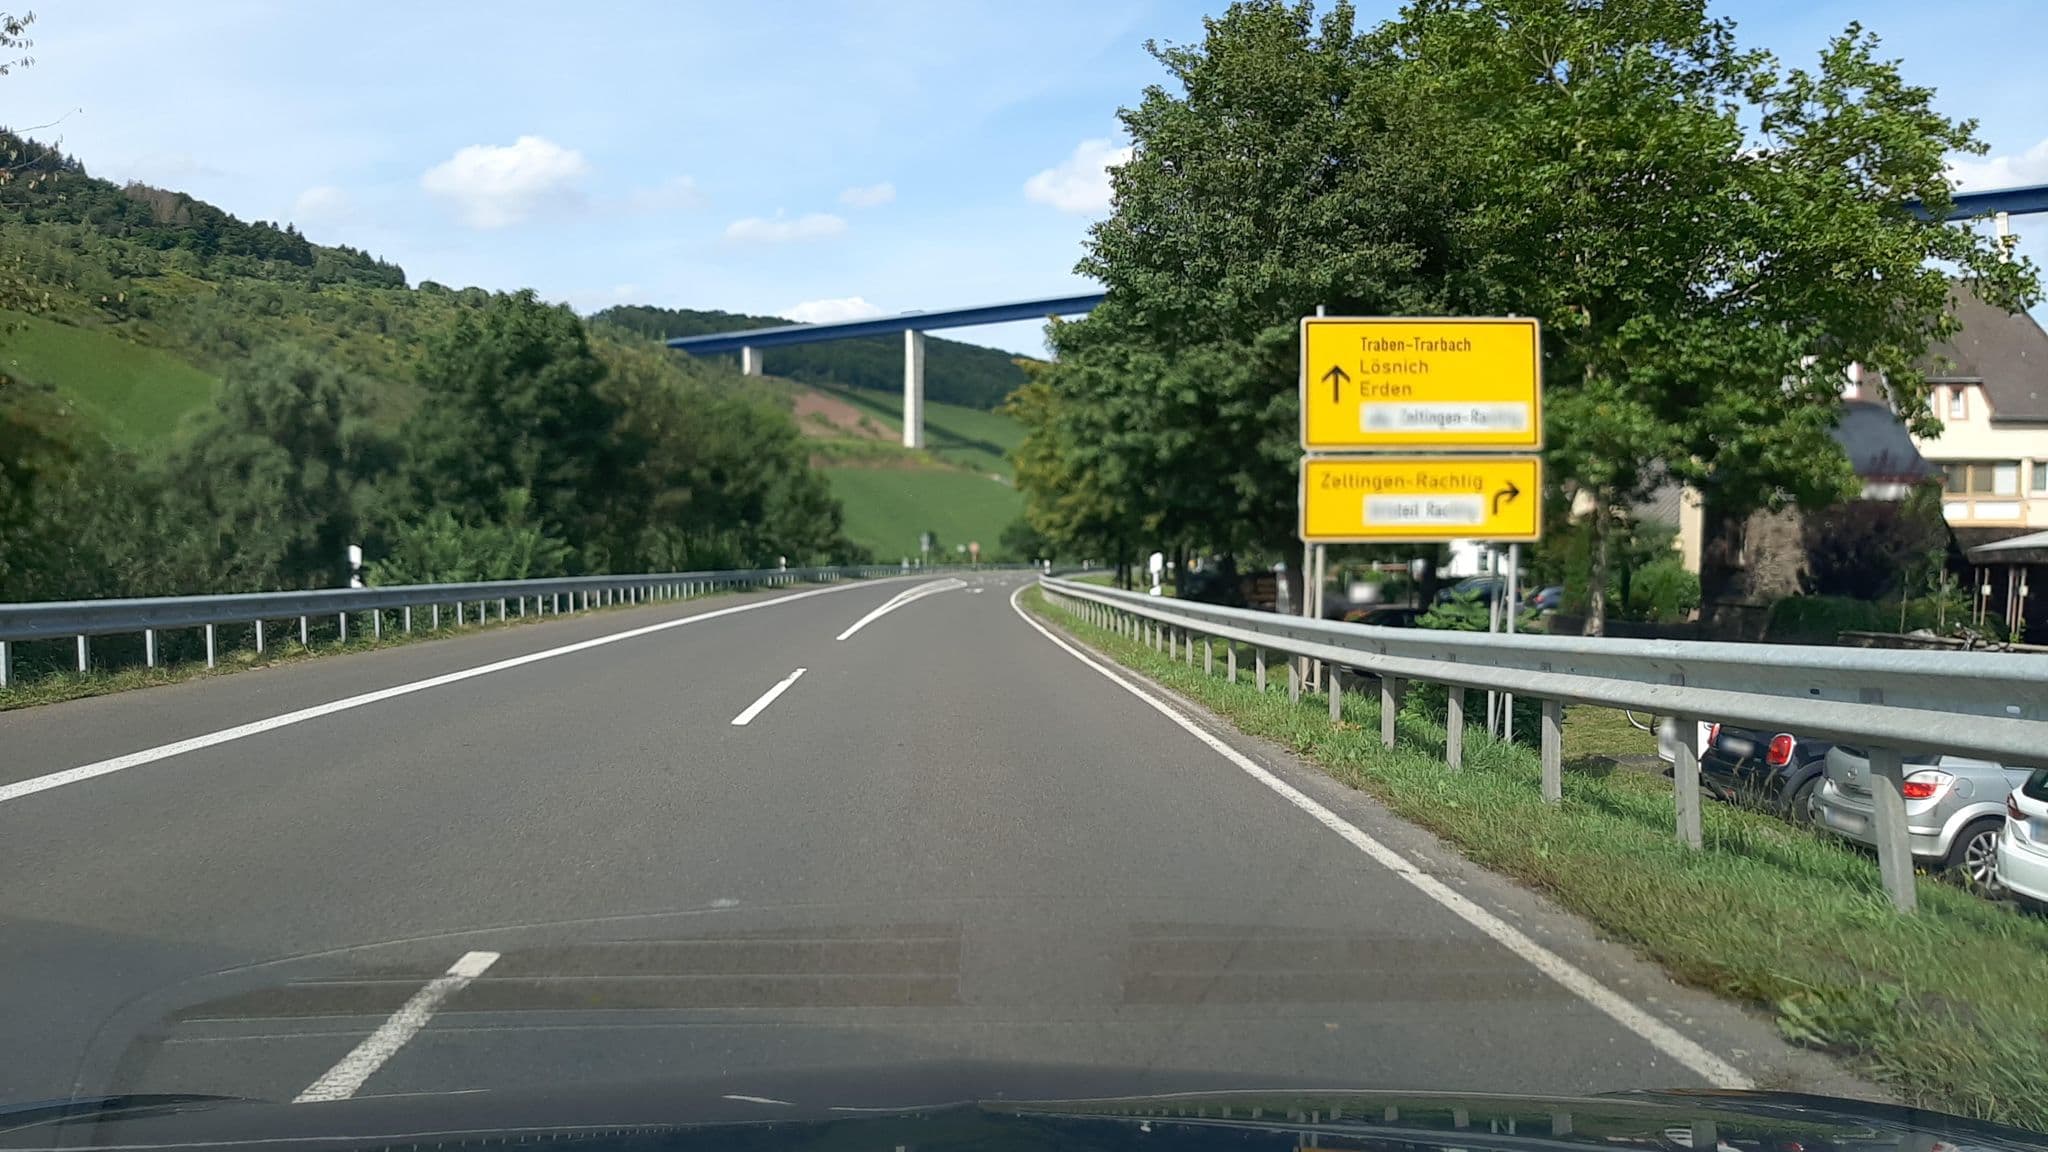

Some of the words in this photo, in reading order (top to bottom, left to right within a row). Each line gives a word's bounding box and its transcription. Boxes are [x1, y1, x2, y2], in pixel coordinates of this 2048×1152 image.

[1361, 337, 1471, 352] Traben-Trarbach
[1360, 360, 1428, 374] Lösnich
[1360, 381, 1412, 396] Erden
[1321, 472, 1483, 491] Zeltingen-Rachtig
